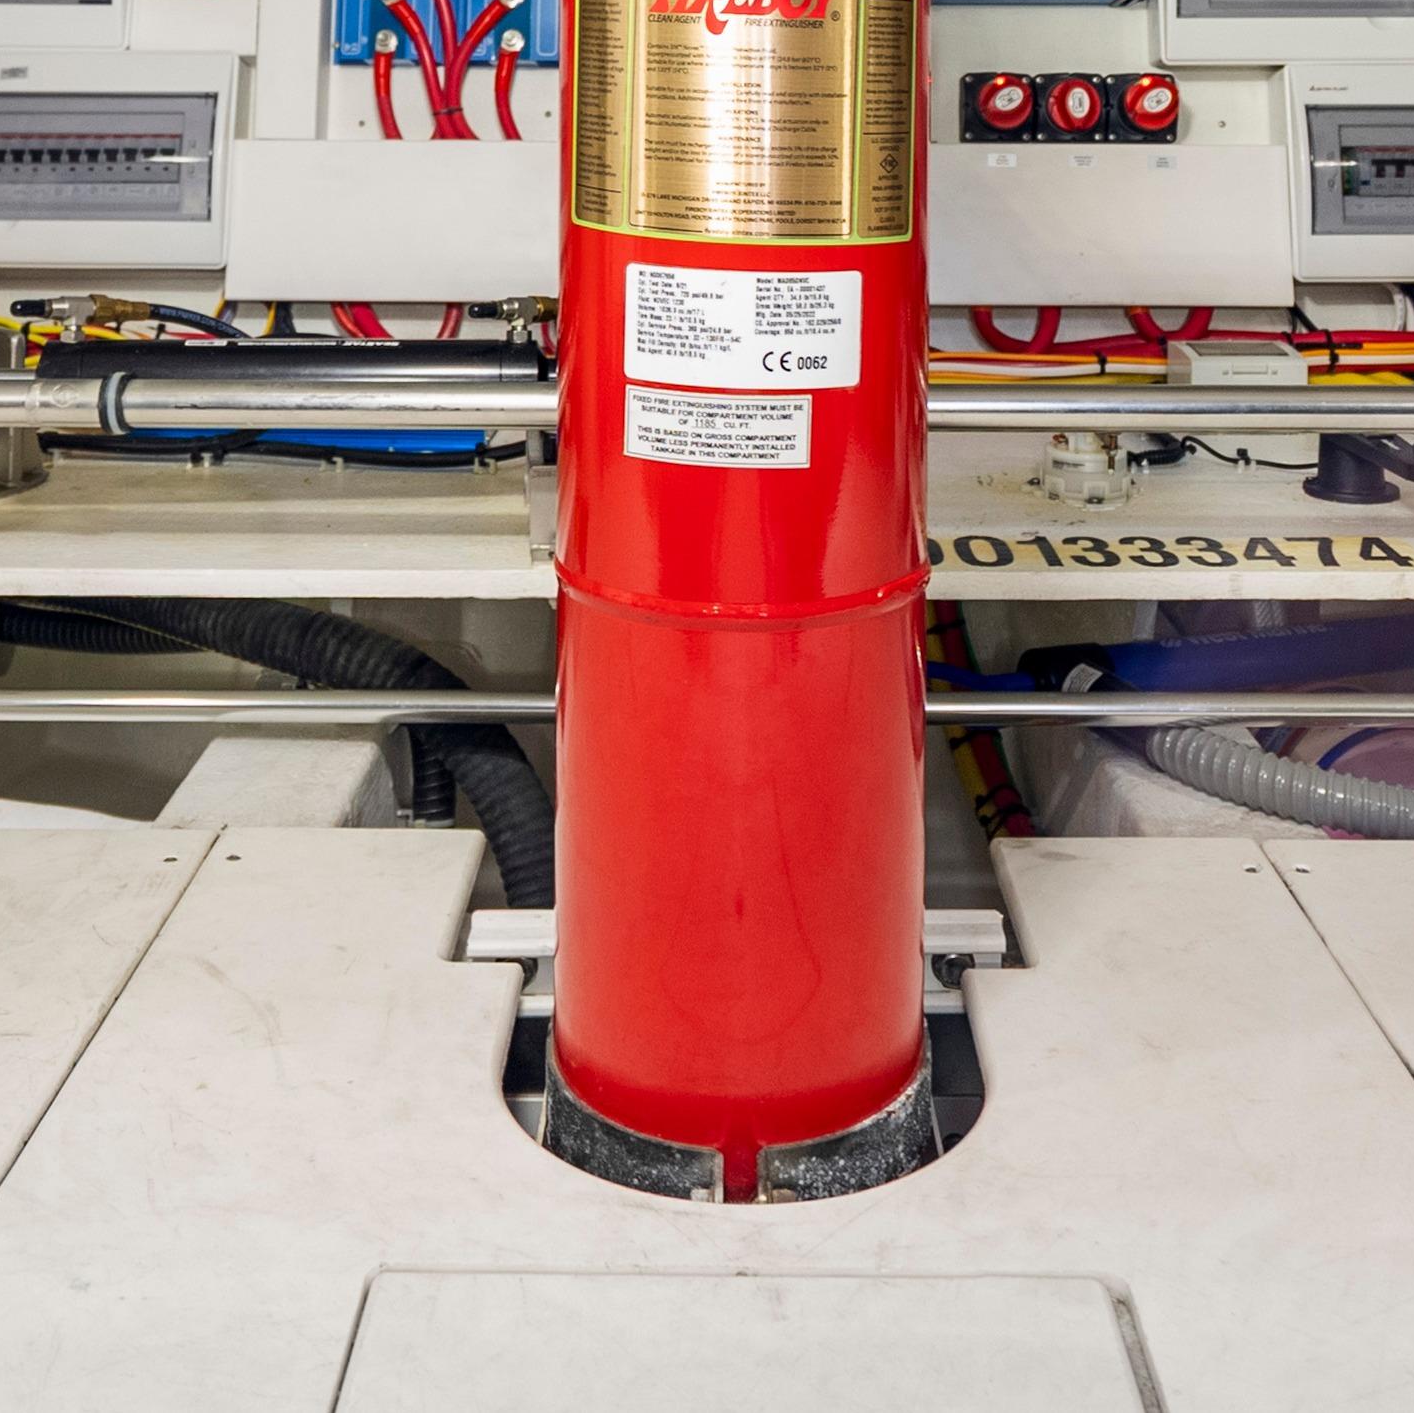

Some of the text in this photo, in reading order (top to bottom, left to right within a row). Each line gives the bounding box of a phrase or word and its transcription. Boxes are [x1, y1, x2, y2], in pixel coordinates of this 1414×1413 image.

[648, 14, 825, 29] CLEAN AGENT FIRE EXTINGUISHER
[762, 350, 828, 372] CE 0062
[633, 394, 652, 403] FIXED
[654, 397, 670, 406] FIRE
[672, 400, 733, 411] EXTINGUISHING
[641, 405, 676, 415] SUITABLE
[696, 411, 758, 420] COMPARTMENT
[761, 413, 794, 421] VOLUME
[695, 418, 717, 428] 1185
[638, 425, 652, 433] THIS
[663, 429, 689, 438] BASED
[704, 433, 733, 441] GROSS
[735, 434, 797, 442] COMPARTMENT
[638, 434, 667, 444] VOLUME
[669, 439, 689, 447] LESS
[690, 441, 750, 450] PERMANENTLY
[651, 445, 686, 456] TANKAGE
[699, 450, 716, 458] THIS
[718, 451, 780, 459] COMPARTMENT
